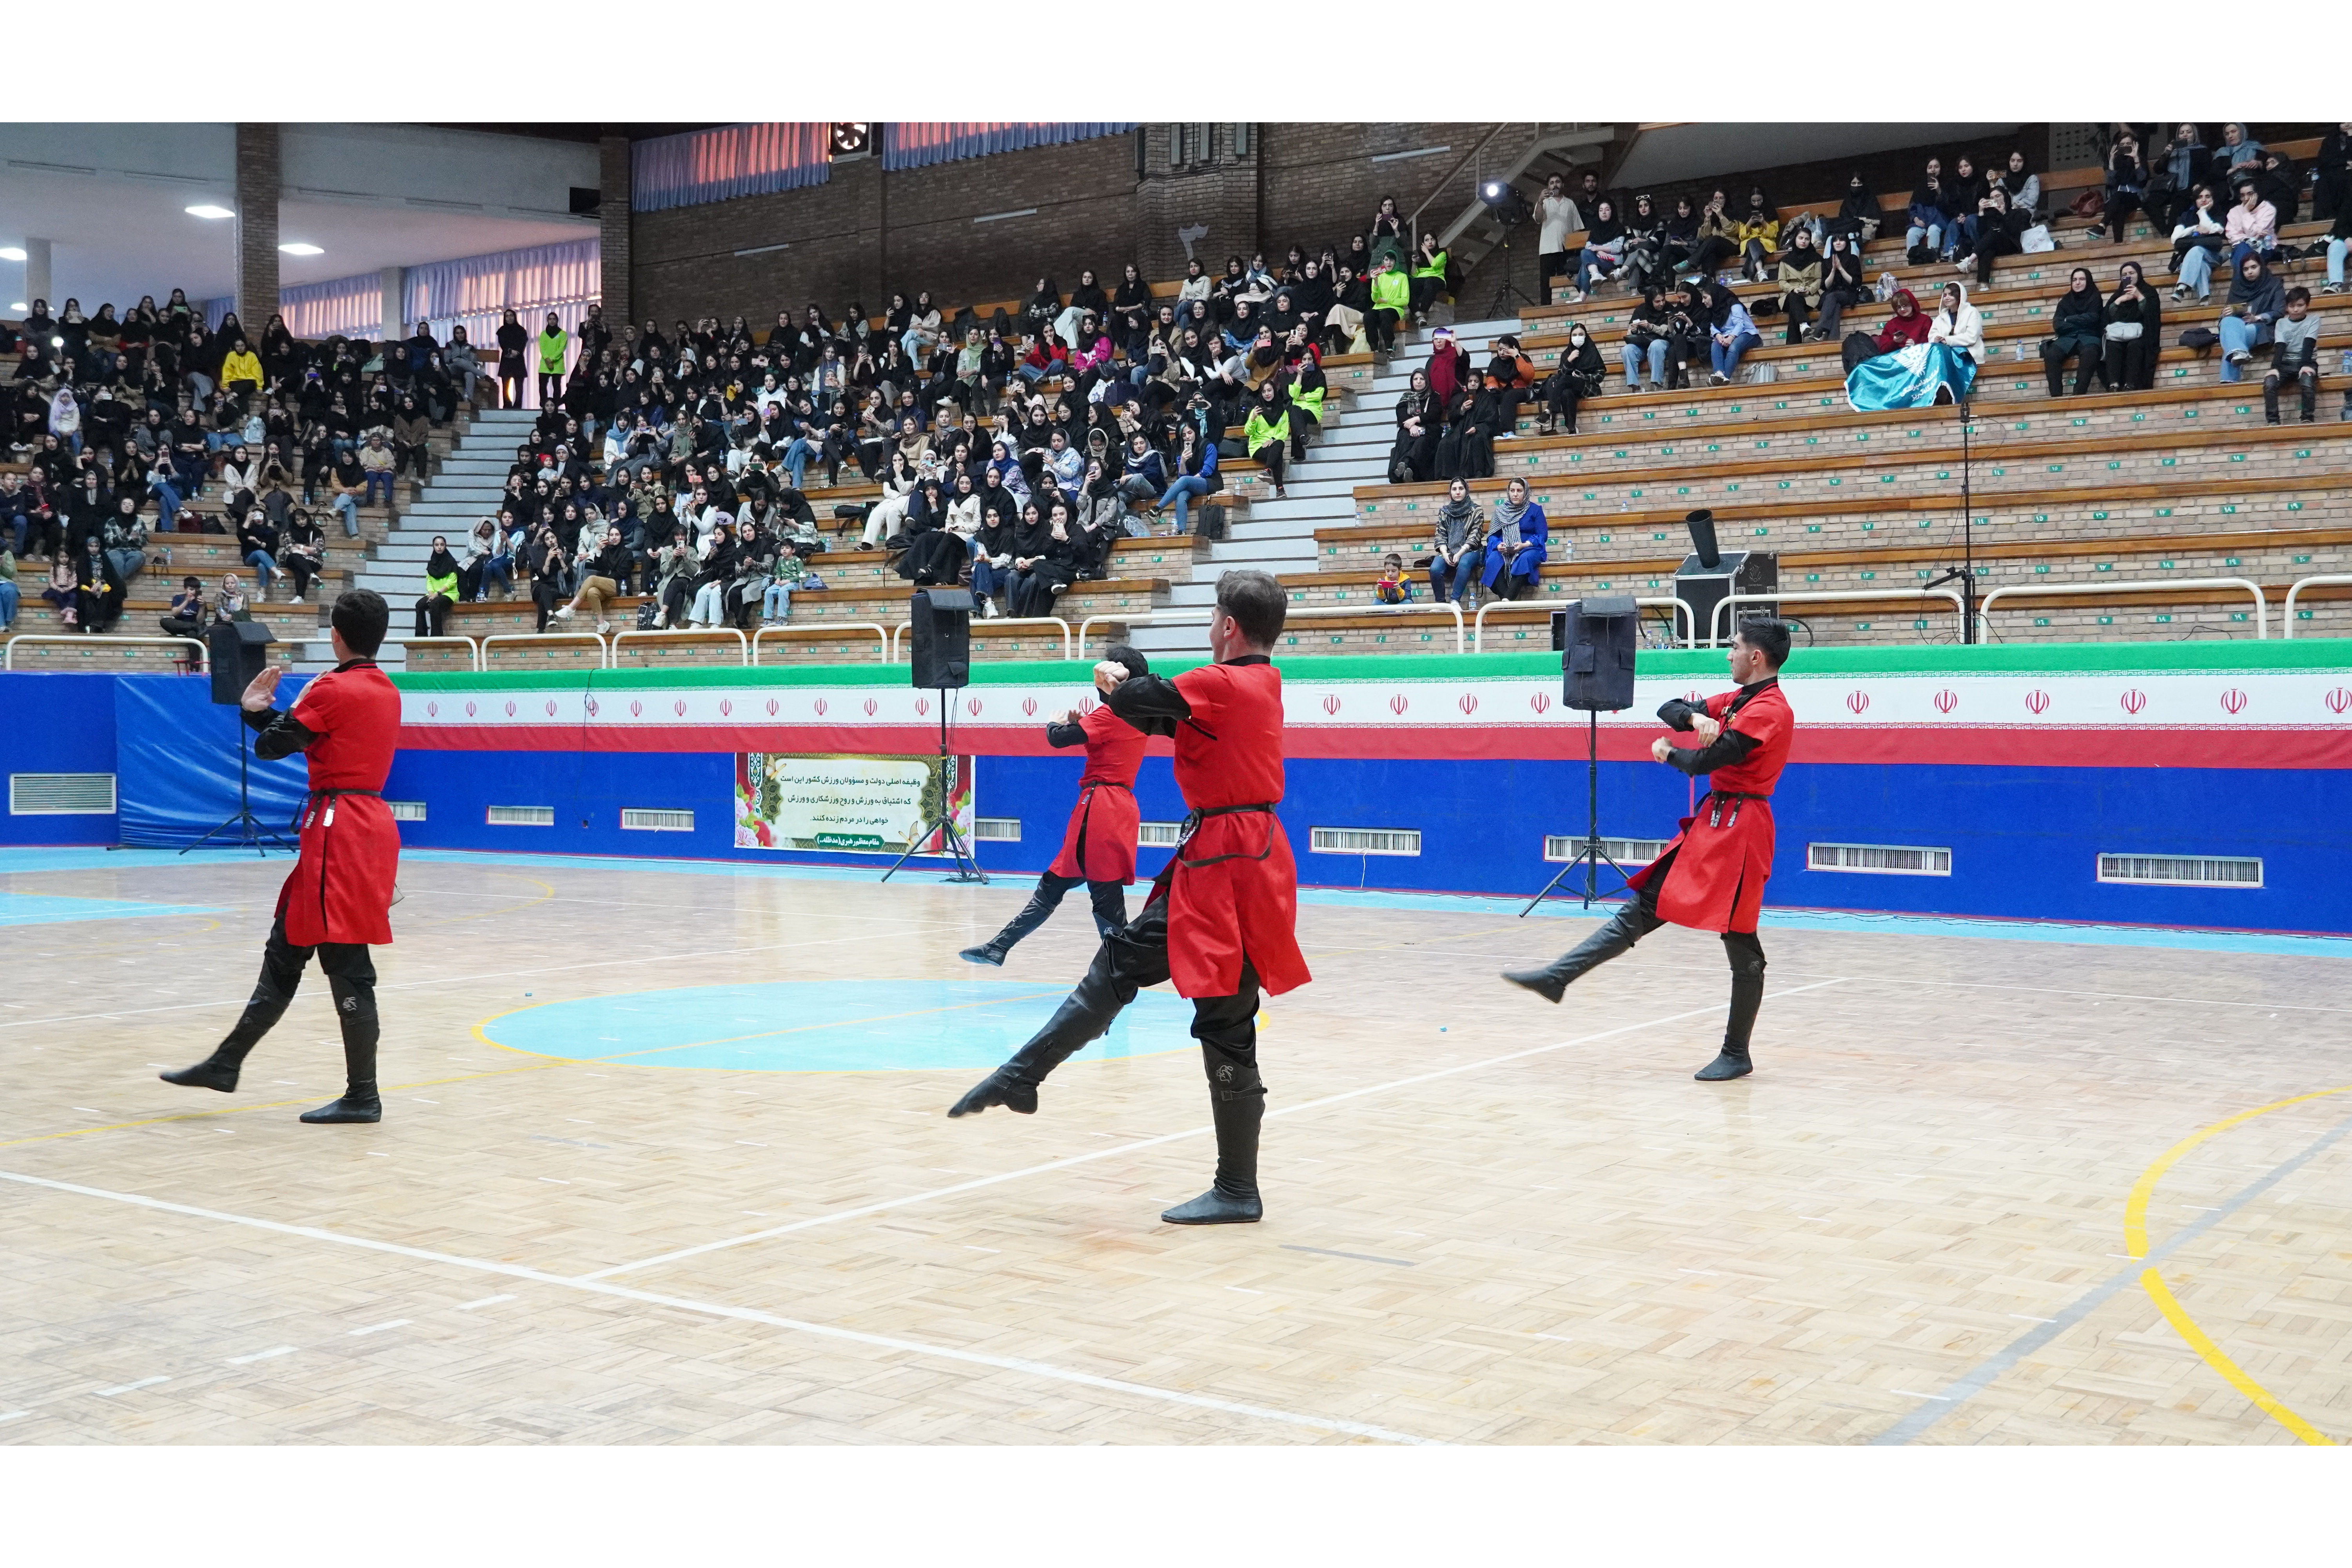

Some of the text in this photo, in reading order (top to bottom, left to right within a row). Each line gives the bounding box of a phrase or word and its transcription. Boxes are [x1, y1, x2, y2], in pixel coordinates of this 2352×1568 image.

[805, 776, 820, 784] کشور
[821, 776, 839, 784] ورزش
[902, 778, 920, 787] وظیفه
[788, 795, 805, 803] ورزش
[810, 795, 839, 804] ورزشکاری
[840, 798, 851, 806] روح
[856, 797, 874, 805] ورزش
[882, 797, 902, 806] اشتیاق
[869, 817, 889, 825] خواهی
[840, 838, 856, 847] رهبری
[855, 837, 869, 847] معظم
[868, 838, 880, 847] مقام
